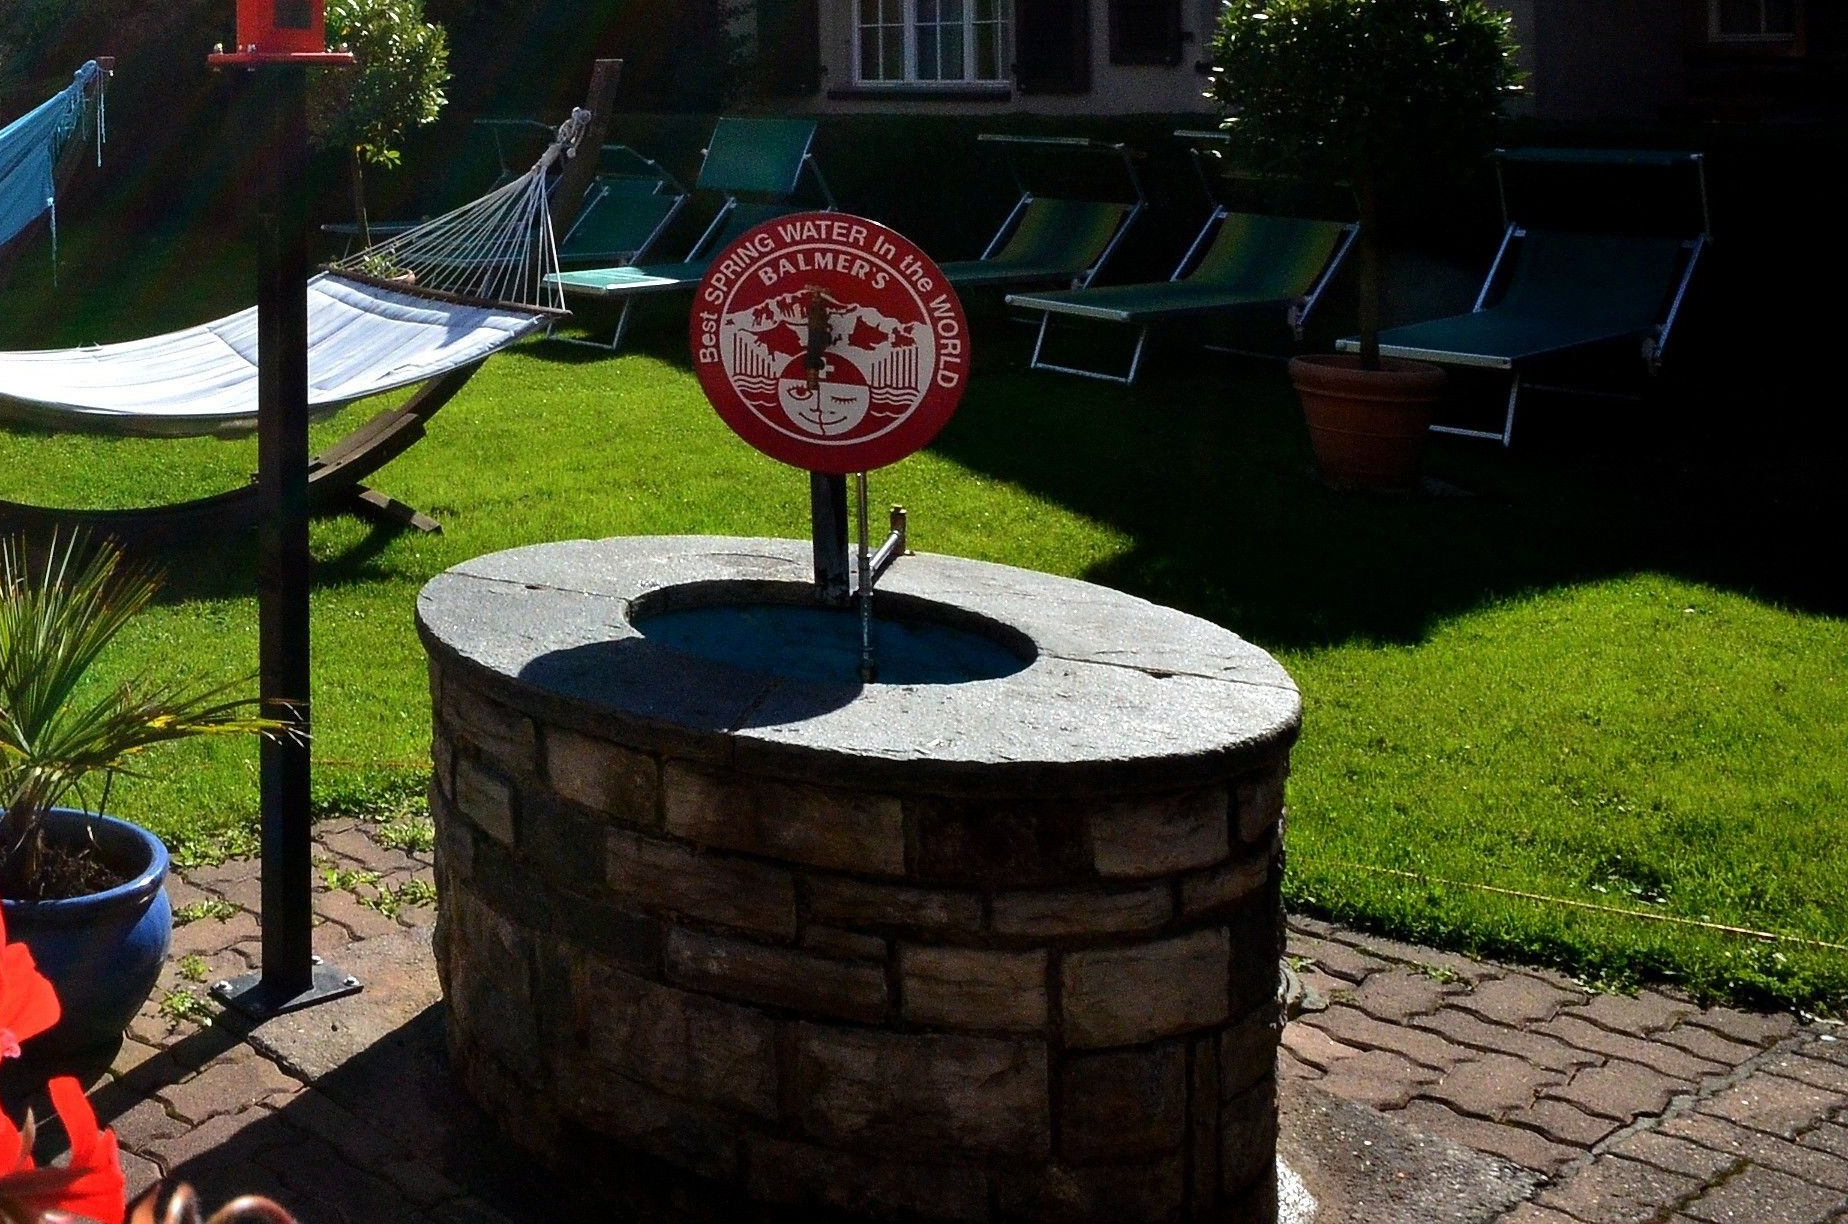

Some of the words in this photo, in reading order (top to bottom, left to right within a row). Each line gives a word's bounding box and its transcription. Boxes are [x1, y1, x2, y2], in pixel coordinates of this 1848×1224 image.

[777, 220, 868, 247] WATER
[704, 233, 776, 306] SPRING
[757, 252, 890, 290] BALMER'S
[899, 254, 934, 293] the
[699, 311, 719, 364] Best
[929, 293, 963, 389] WORLD
